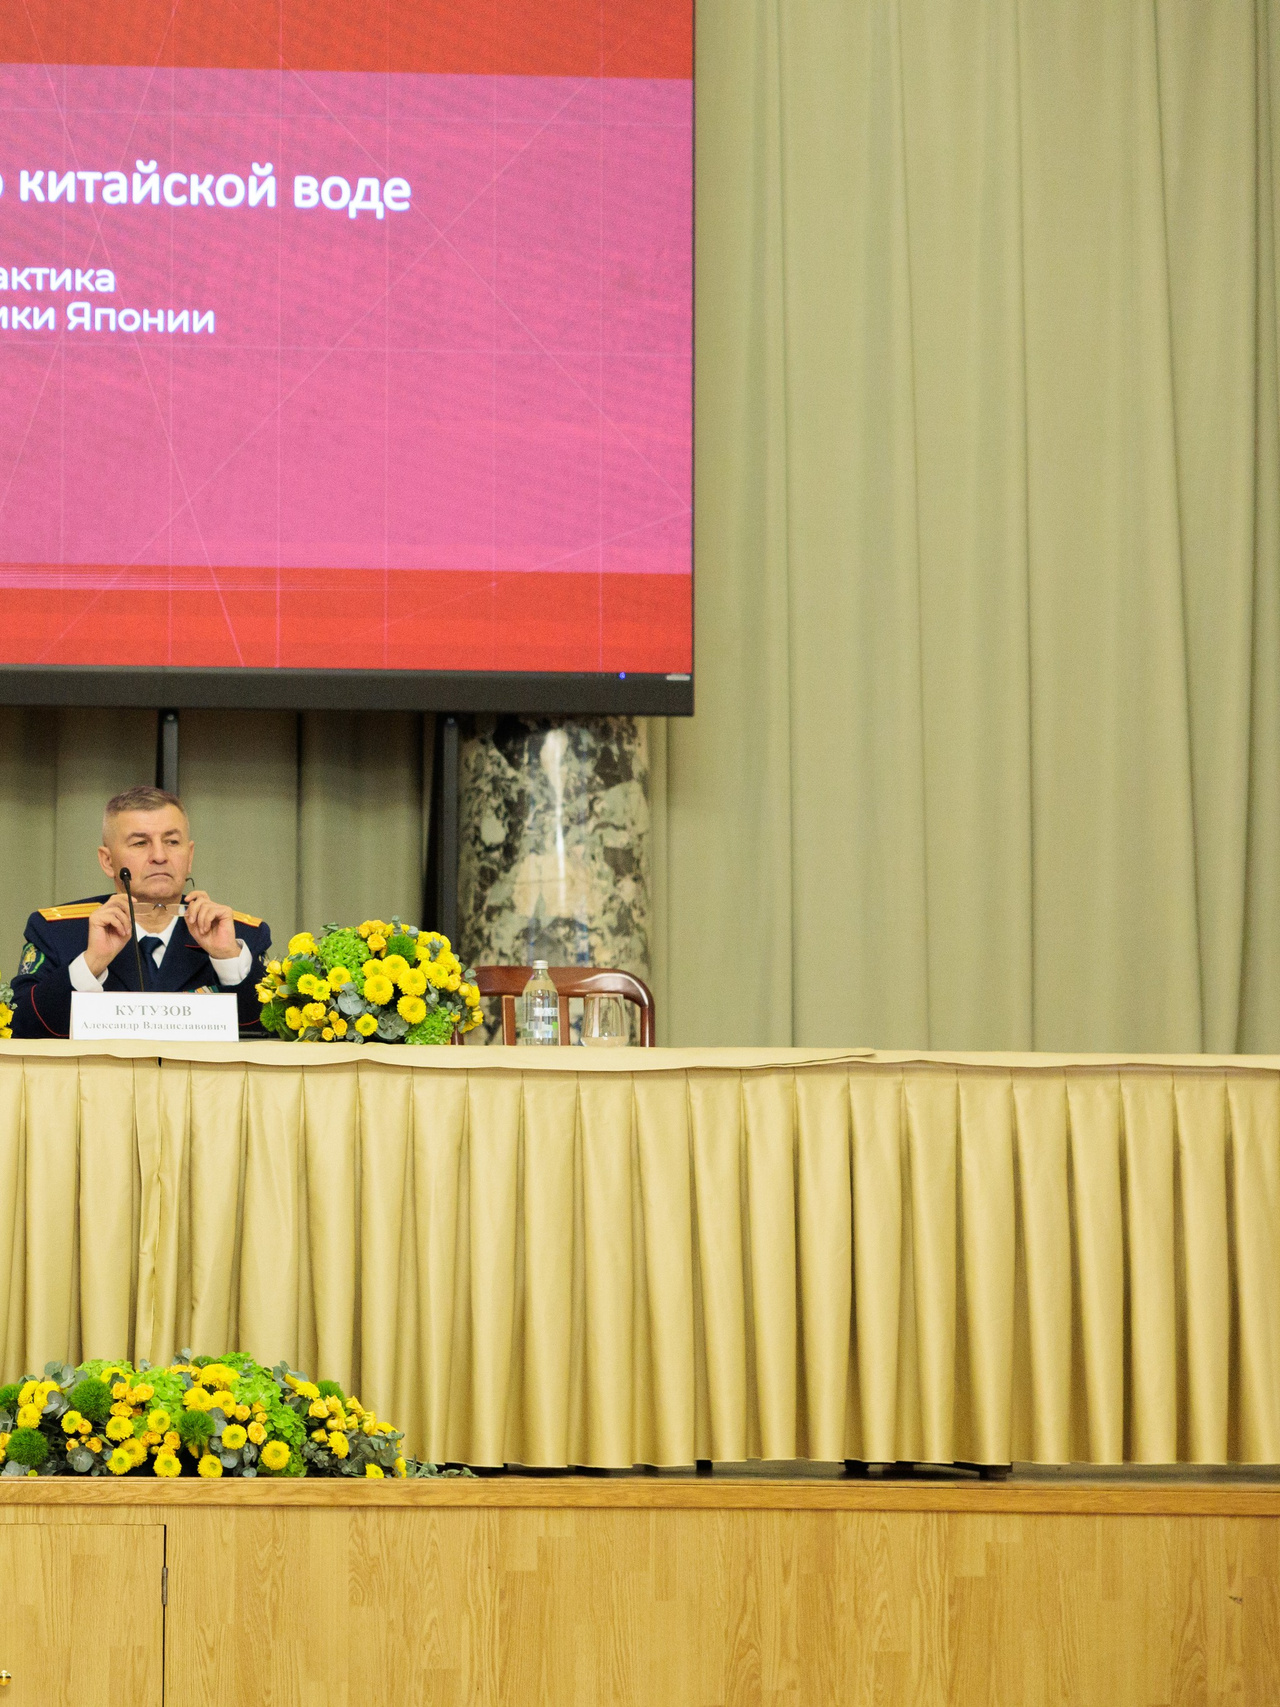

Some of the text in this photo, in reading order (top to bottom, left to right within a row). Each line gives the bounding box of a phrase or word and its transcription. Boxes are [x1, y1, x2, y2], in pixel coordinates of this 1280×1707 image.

[18, 158, 278, 209] китайской
[292, 174, 413, 221] воде
[65, 300, 216, 335] Японии
[115, 1004, 192, 1017] КУТУЗОВ
[81, 1020, 228, 1032] Александр Владиславович
